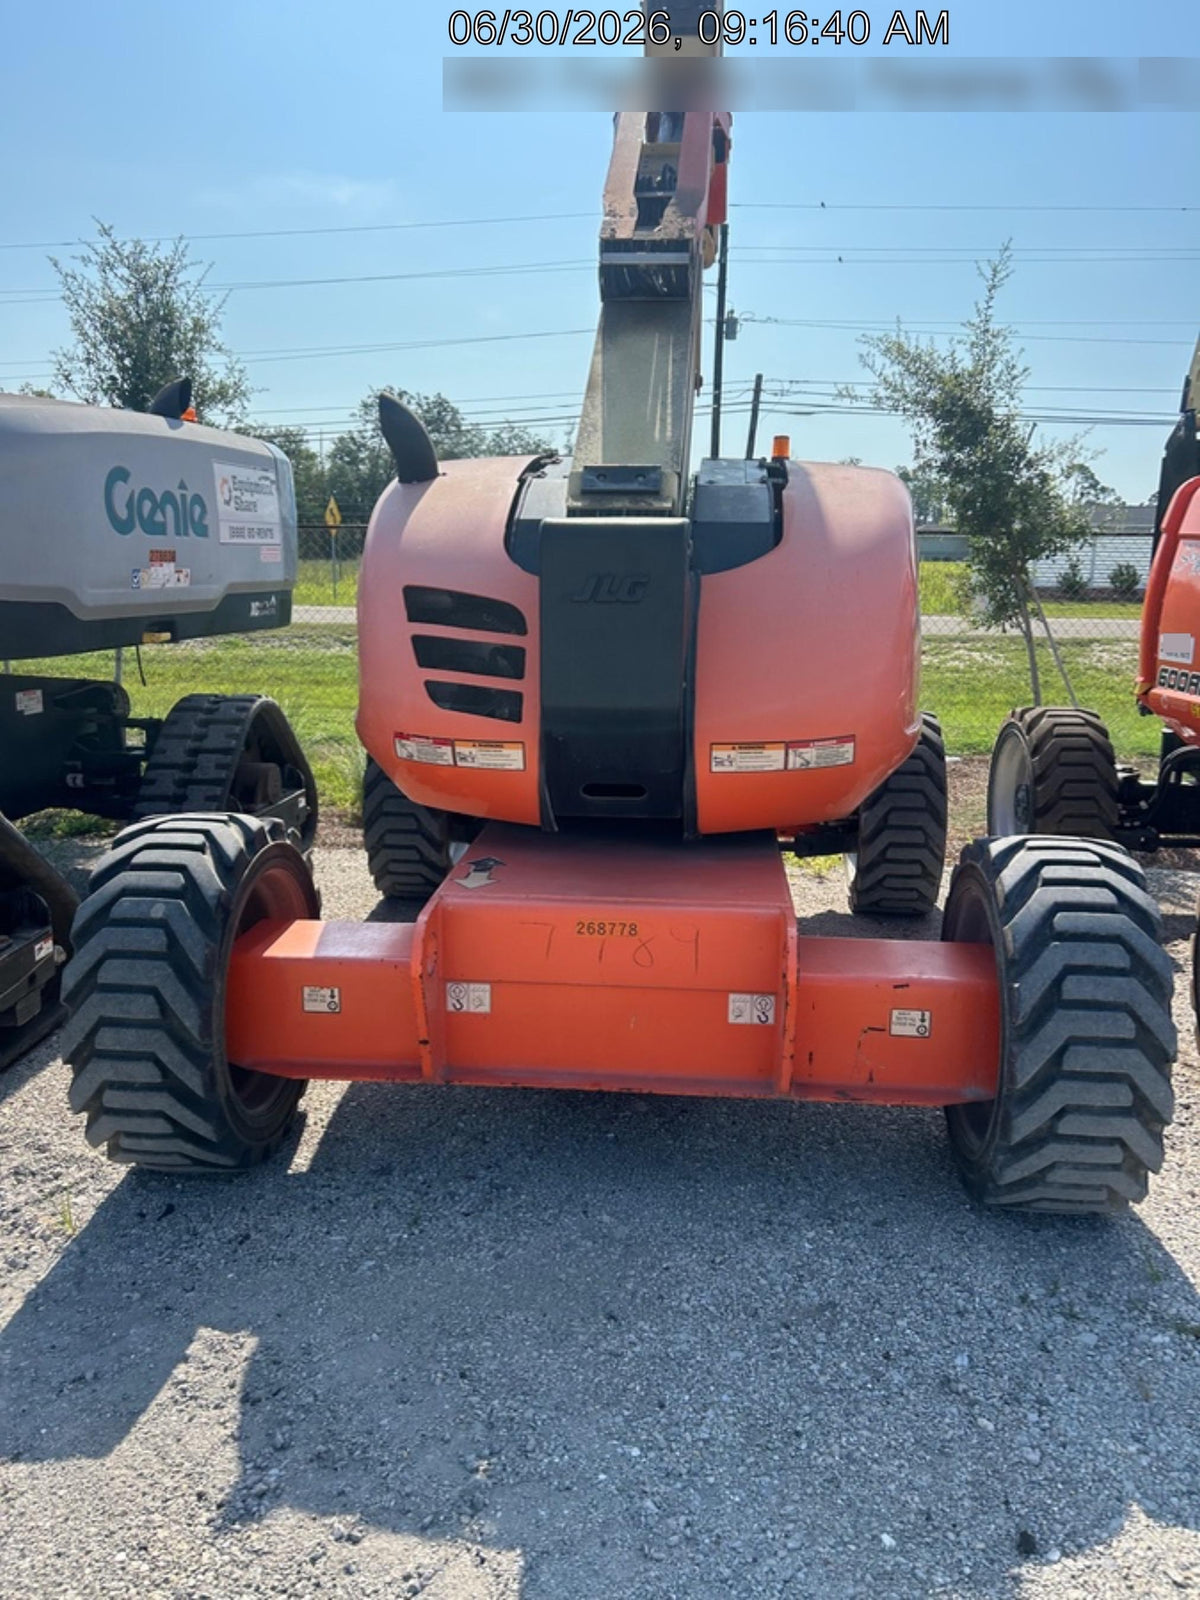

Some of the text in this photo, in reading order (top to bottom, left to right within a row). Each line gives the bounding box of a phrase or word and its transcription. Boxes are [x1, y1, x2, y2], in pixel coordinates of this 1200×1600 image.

[104, 465, 209, 538] Genie
[561, 574, 651, 605] JLG
[1157, 667, 1200, 696] 600A
[576, 921, 638, 937] 268778
